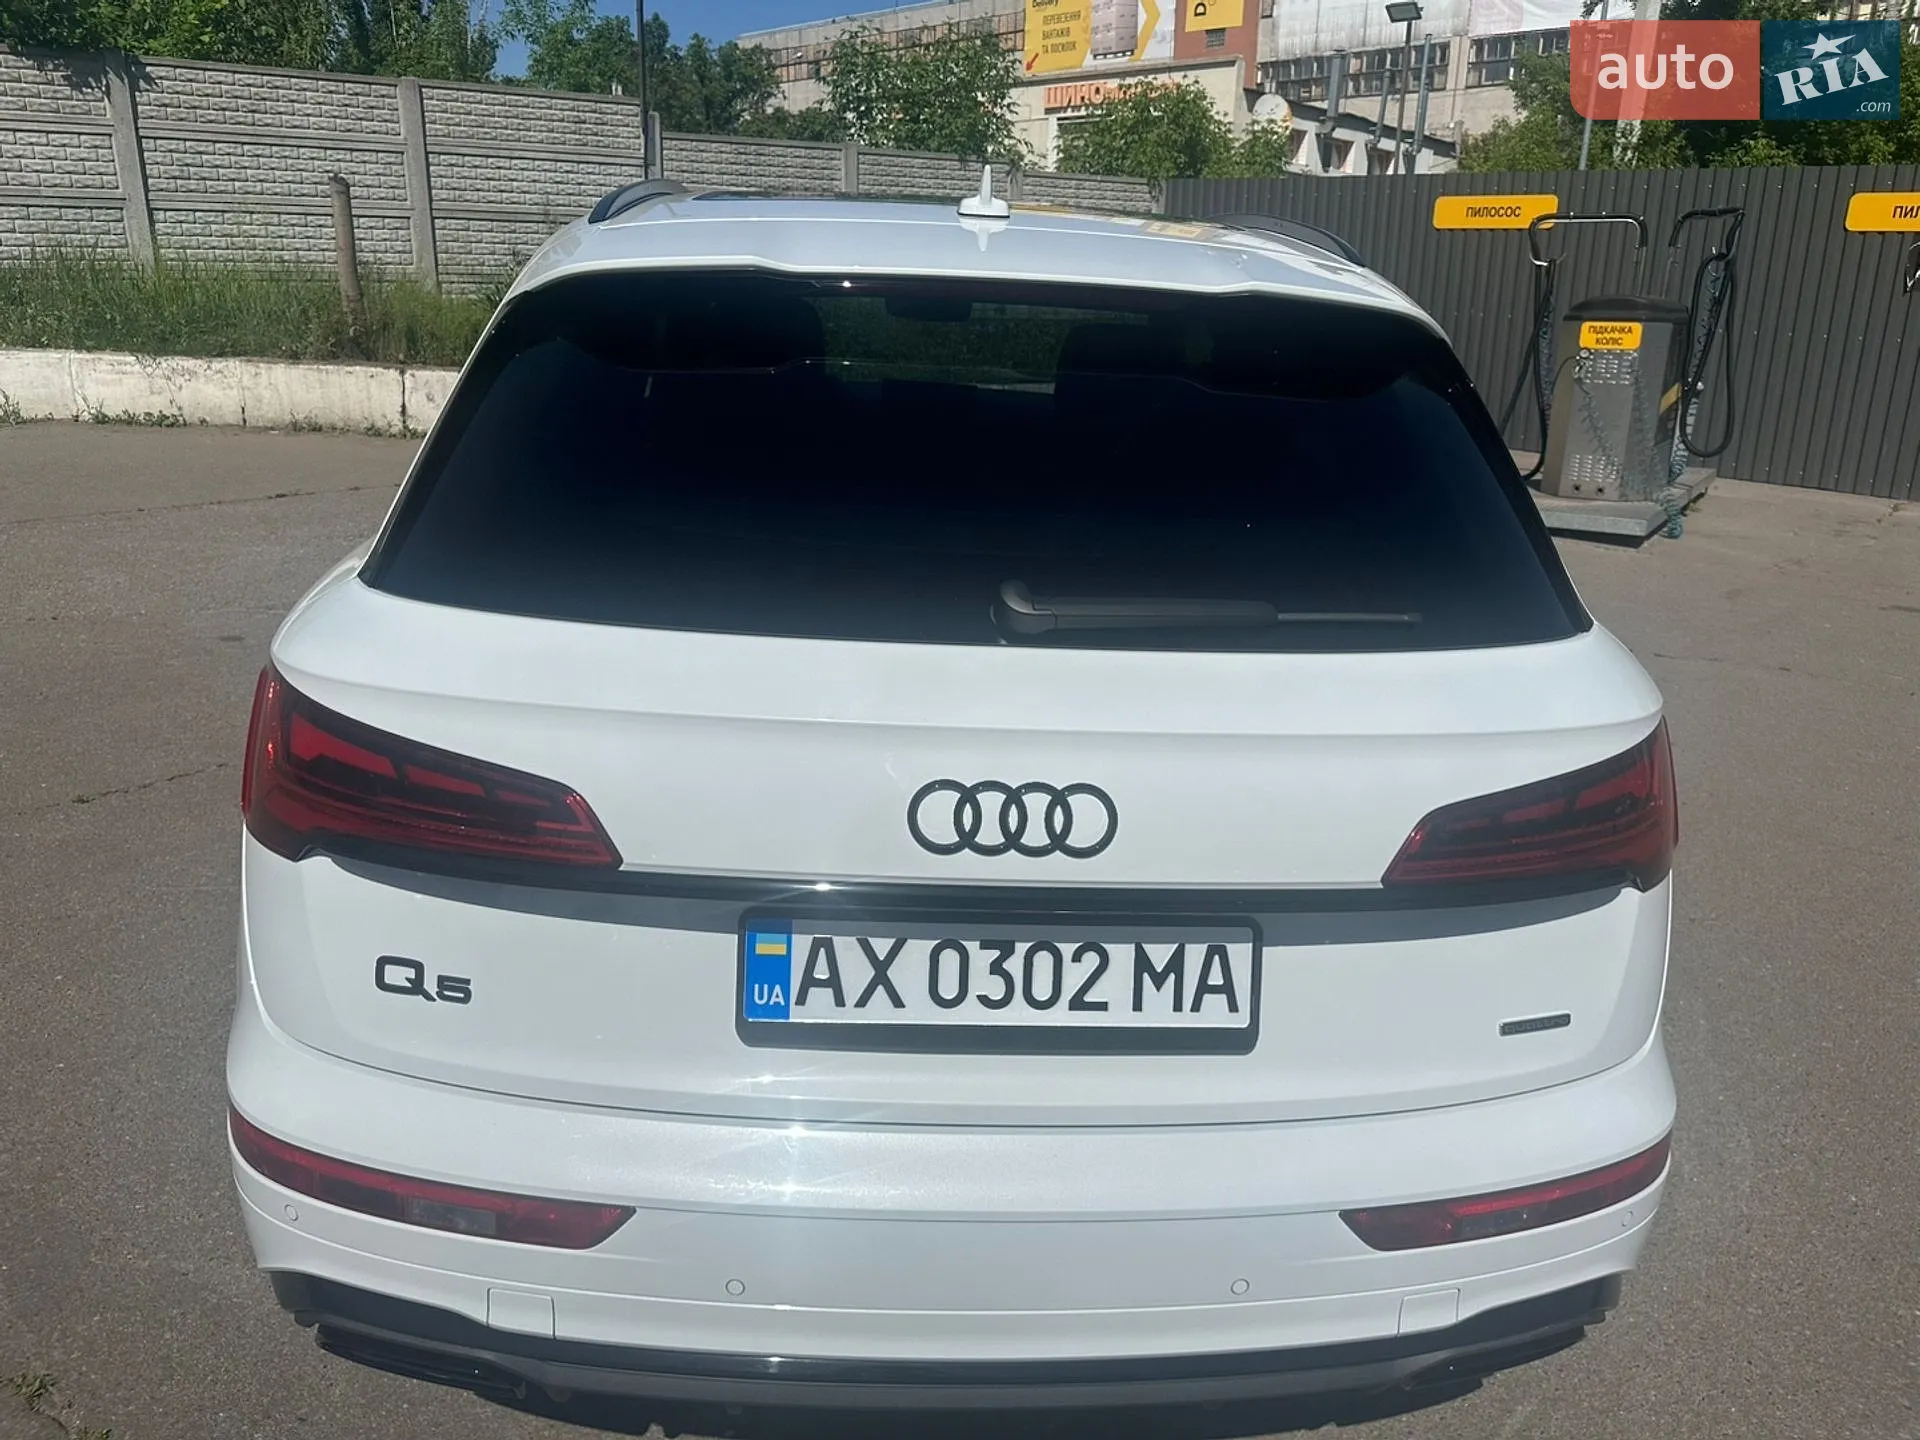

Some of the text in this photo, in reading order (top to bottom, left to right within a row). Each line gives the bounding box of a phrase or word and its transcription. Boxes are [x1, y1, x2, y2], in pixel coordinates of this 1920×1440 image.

[1465, 206, 1522, 218] ПИЛОСОС
[1588, 325, 1633, 335] ПІДКАЧКА
[1595, 337, 1624, 346] КОЛІС
[374, 955, 473, 1005] Q5
[794, 935, 1240, 1014] AX 0302 MA
[753, 984, 786, 1007] UA
